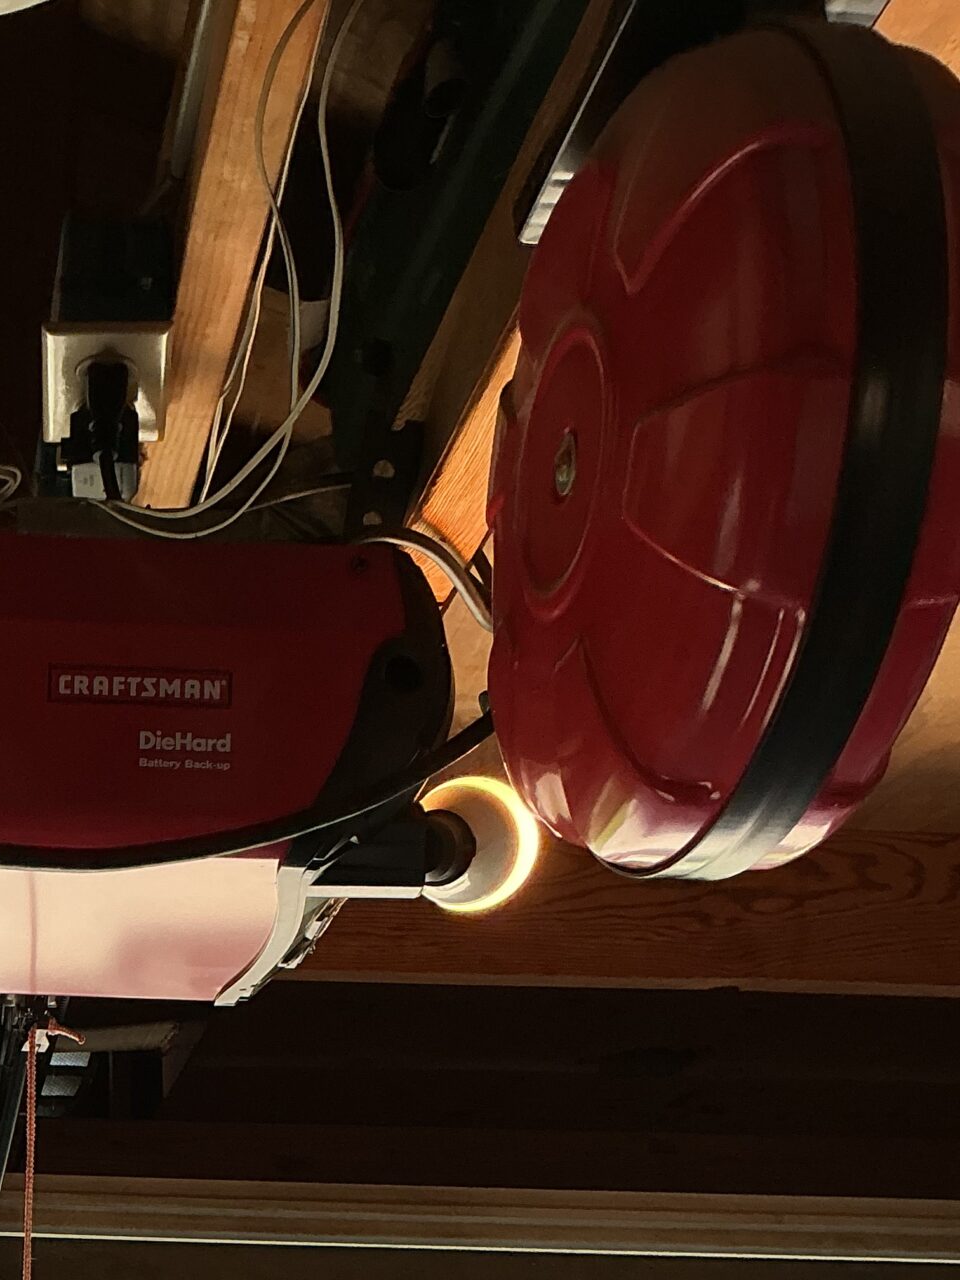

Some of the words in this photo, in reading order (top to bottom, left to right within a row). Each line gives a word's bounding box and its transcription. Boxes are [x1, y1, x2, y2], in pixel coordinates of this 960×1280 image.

[58, 674, 221, 700] CRAFTSMAN
[139, 730, 232, 753] DieHard
[139, 757, 182, 771] Battery
[185, 758, 231, 771] Back-up
